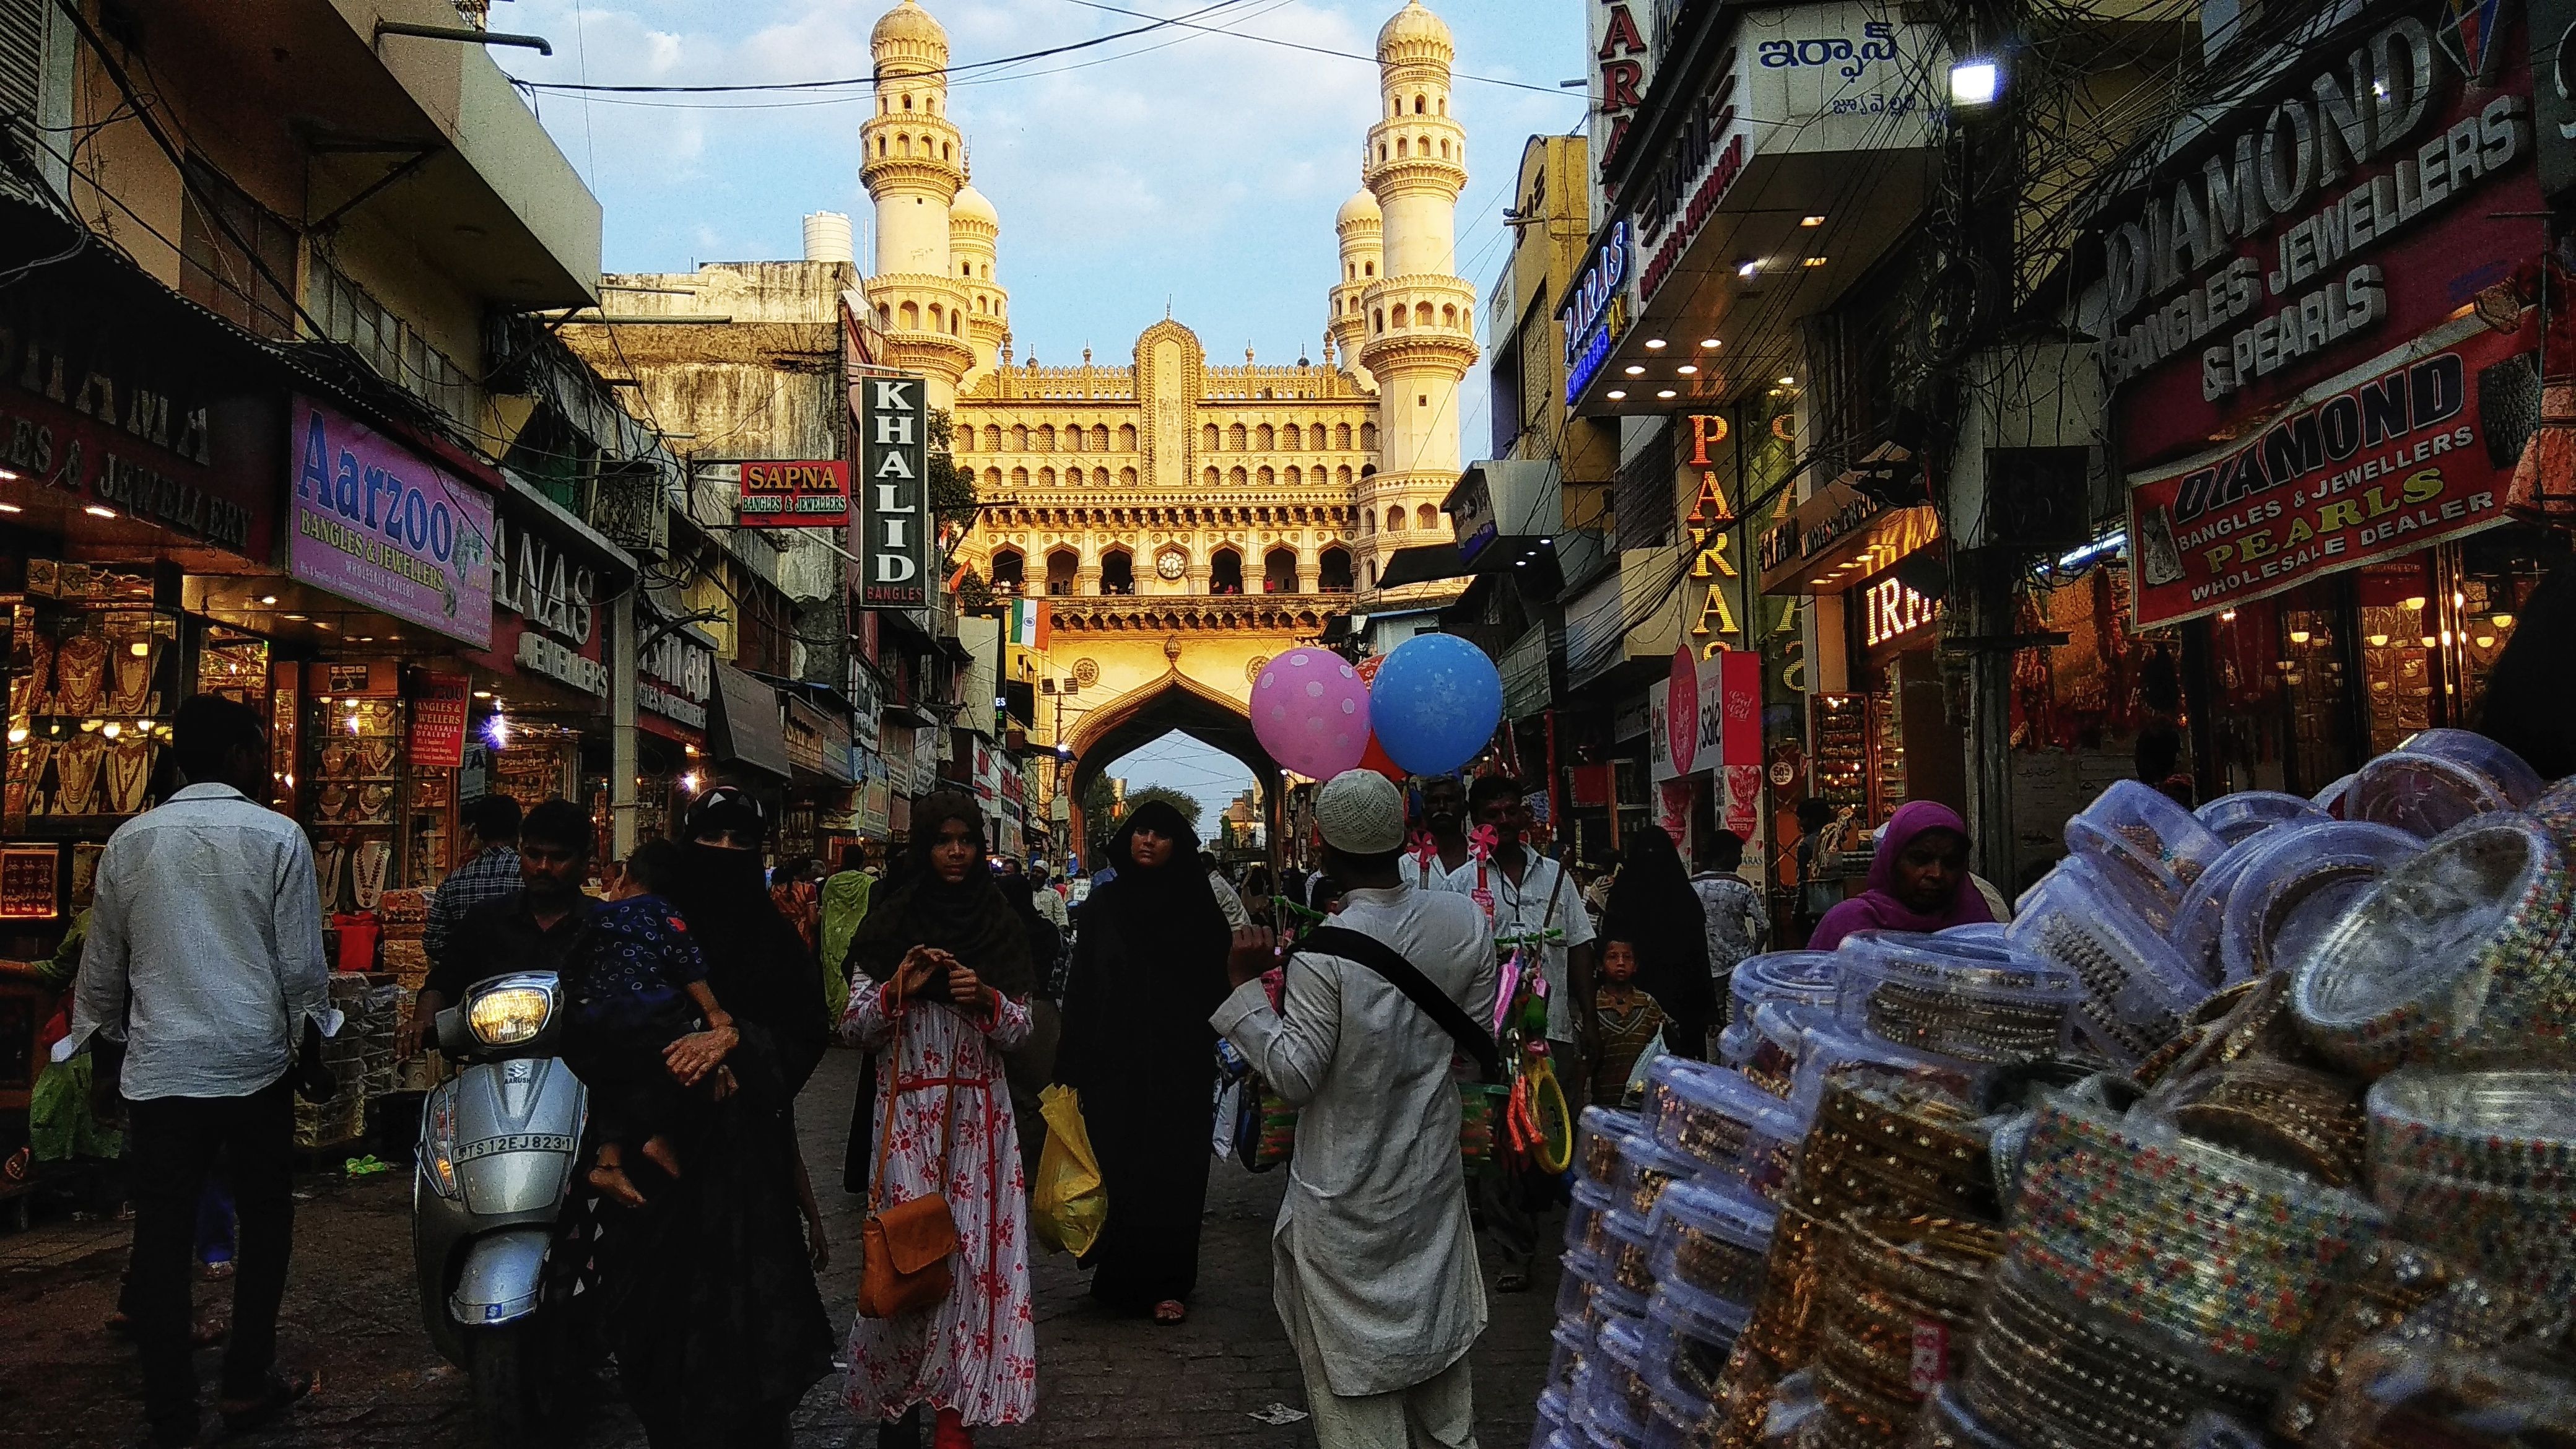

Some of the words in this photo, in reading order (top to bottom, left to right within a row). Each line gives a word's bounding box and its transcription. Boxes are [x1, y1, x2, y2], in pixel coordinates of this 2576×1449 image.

[2105, 16, 2431, 320] DIAMOND
[1564, 222, 1624, 365] PARAS
[2105, 257, 2260, 388] BANGLES
[2268, 95, 2519, 295] JEWELLERS
[2203, 346, 2234, 402] &
[2233, 265, 2385, 387] PEARLS
[0, 416, 53, 474] ES
[66, 440, 82, 485] &
[297, 407, 452, 564] Aarzoo
[748, 466, 840, 491] SAPNA
[874, 381, 916, 583] KHALID
[2174, 351, 2464, 524] DIAMOND
[2180, 498, 2282, 552] BANGLES
[2293, 489, 2307, 509] &
[2312, 425, 2474, 502] JEWELLERS
[300, 508, 363, 559] BANGLES
[365, 537, 376, 564] &
[378, 541, 445, 593] JEWELLERS
[742, 496, 782, 513] BANGLES
[785, 497, 793, 511] &
[796, 496, 846, 513] JEWELLERS
[2192, 537, 2347, 602] WHOLESALE
[2360, 491, 2495, 547] DEALER
[2203, 466, 2445, 574] PEARLS
[867, 586, 923, 601] BANGLES
[415, 714, 461, 725] WELLERS
[416, 730, 451, 738] DEALERS
[1741, 856, 1763, 865] ARAS
